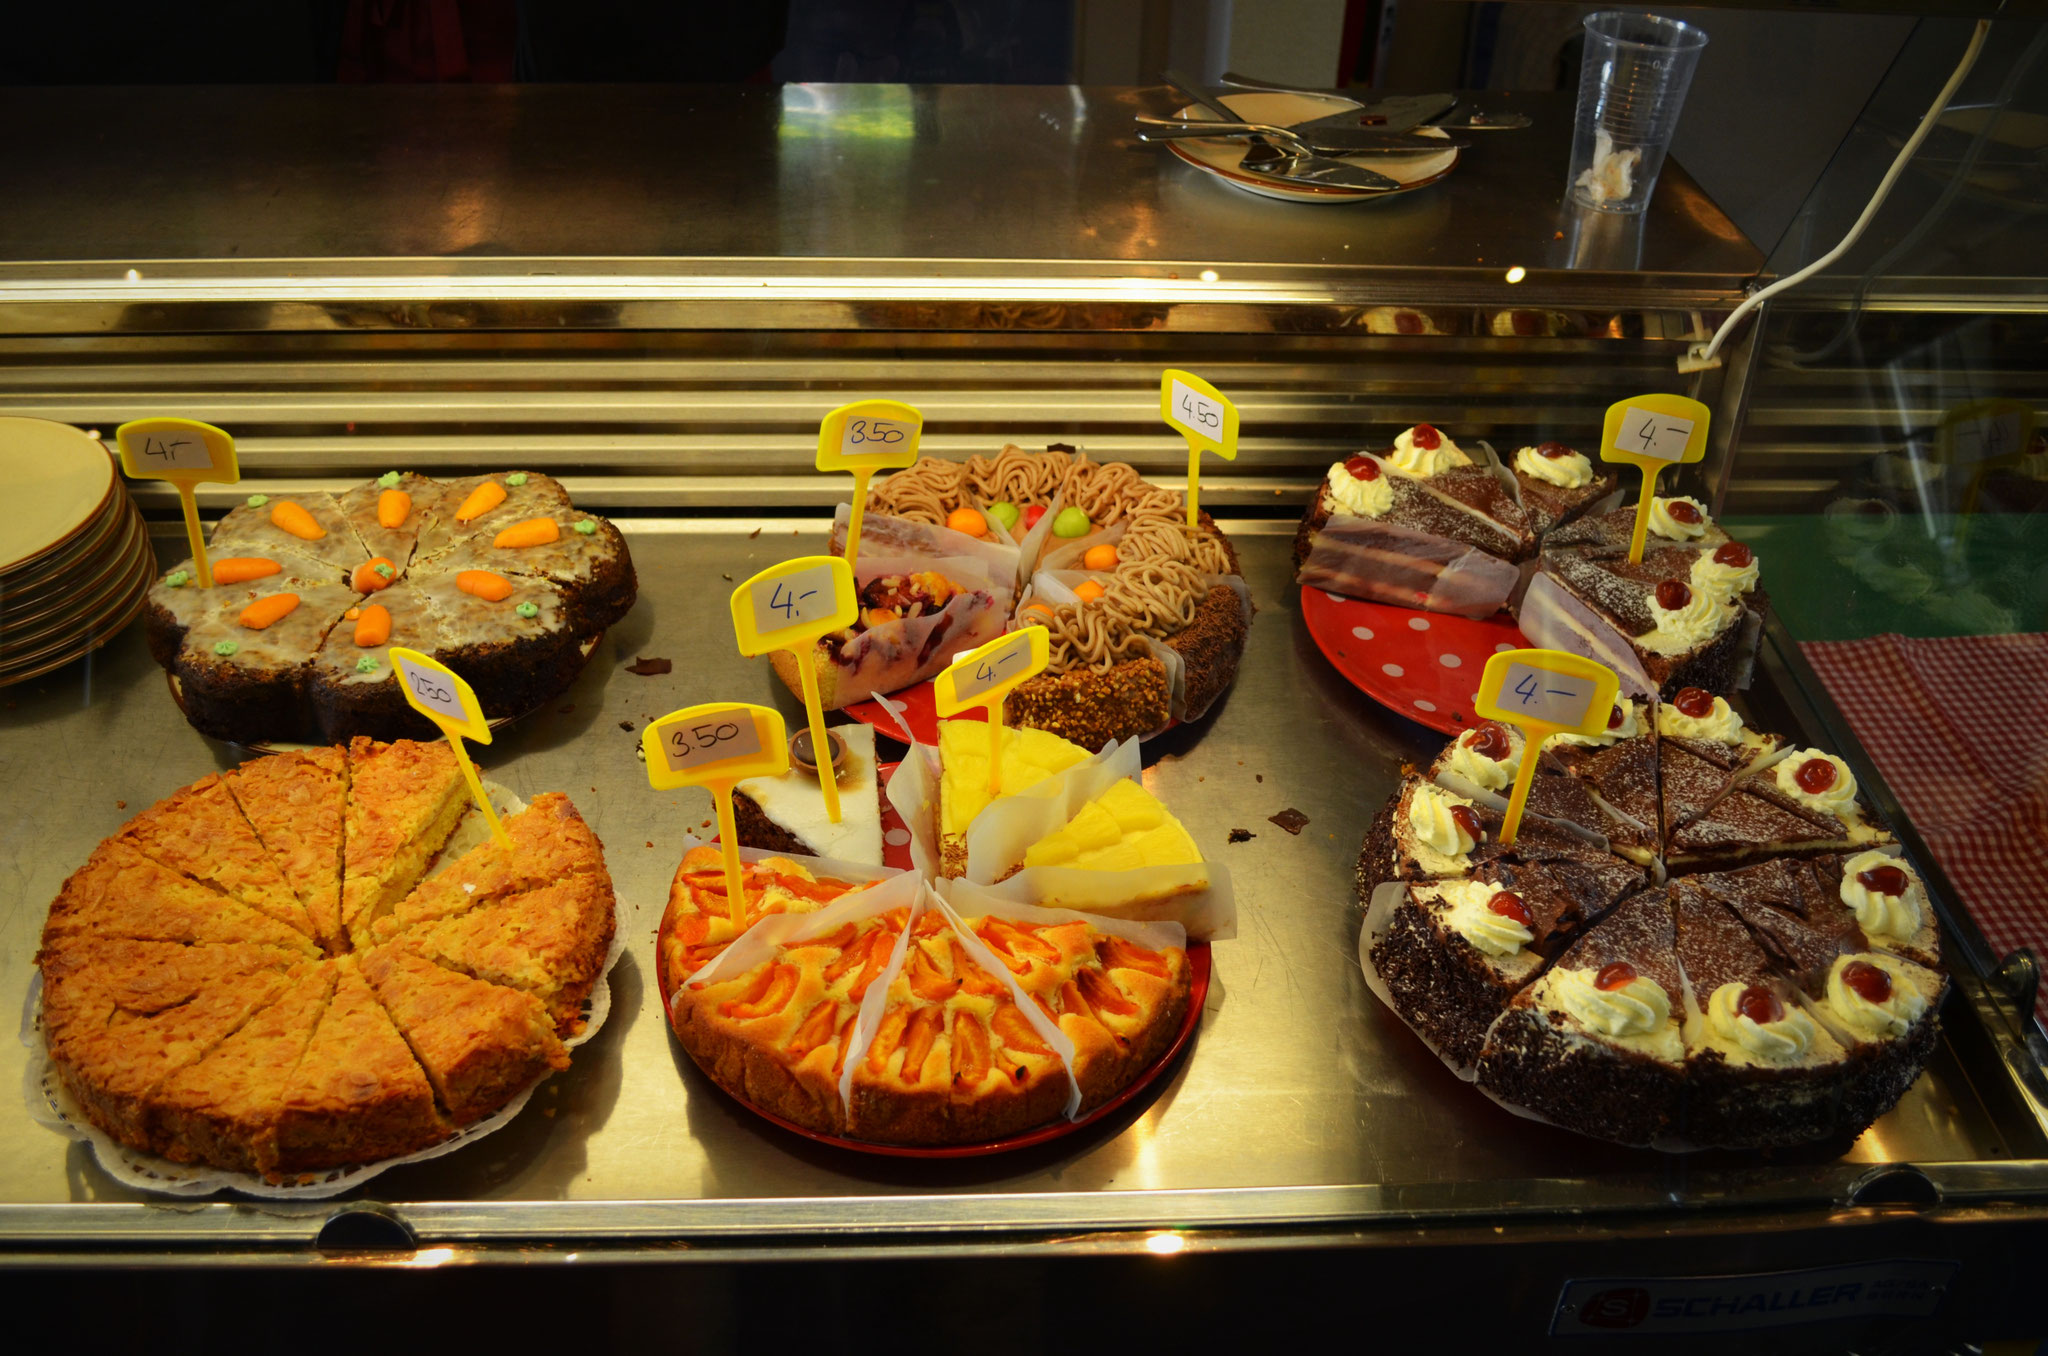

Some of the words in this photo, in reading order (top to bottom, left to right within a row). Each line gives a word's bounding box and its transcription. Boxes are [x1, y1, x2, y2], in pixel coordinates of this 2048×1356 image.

[1182, 394, 1219, 428] 4.50
[671, 722, 739, 757] 3.50
[1653, 1283, 1864, 1318] SCHALLER
